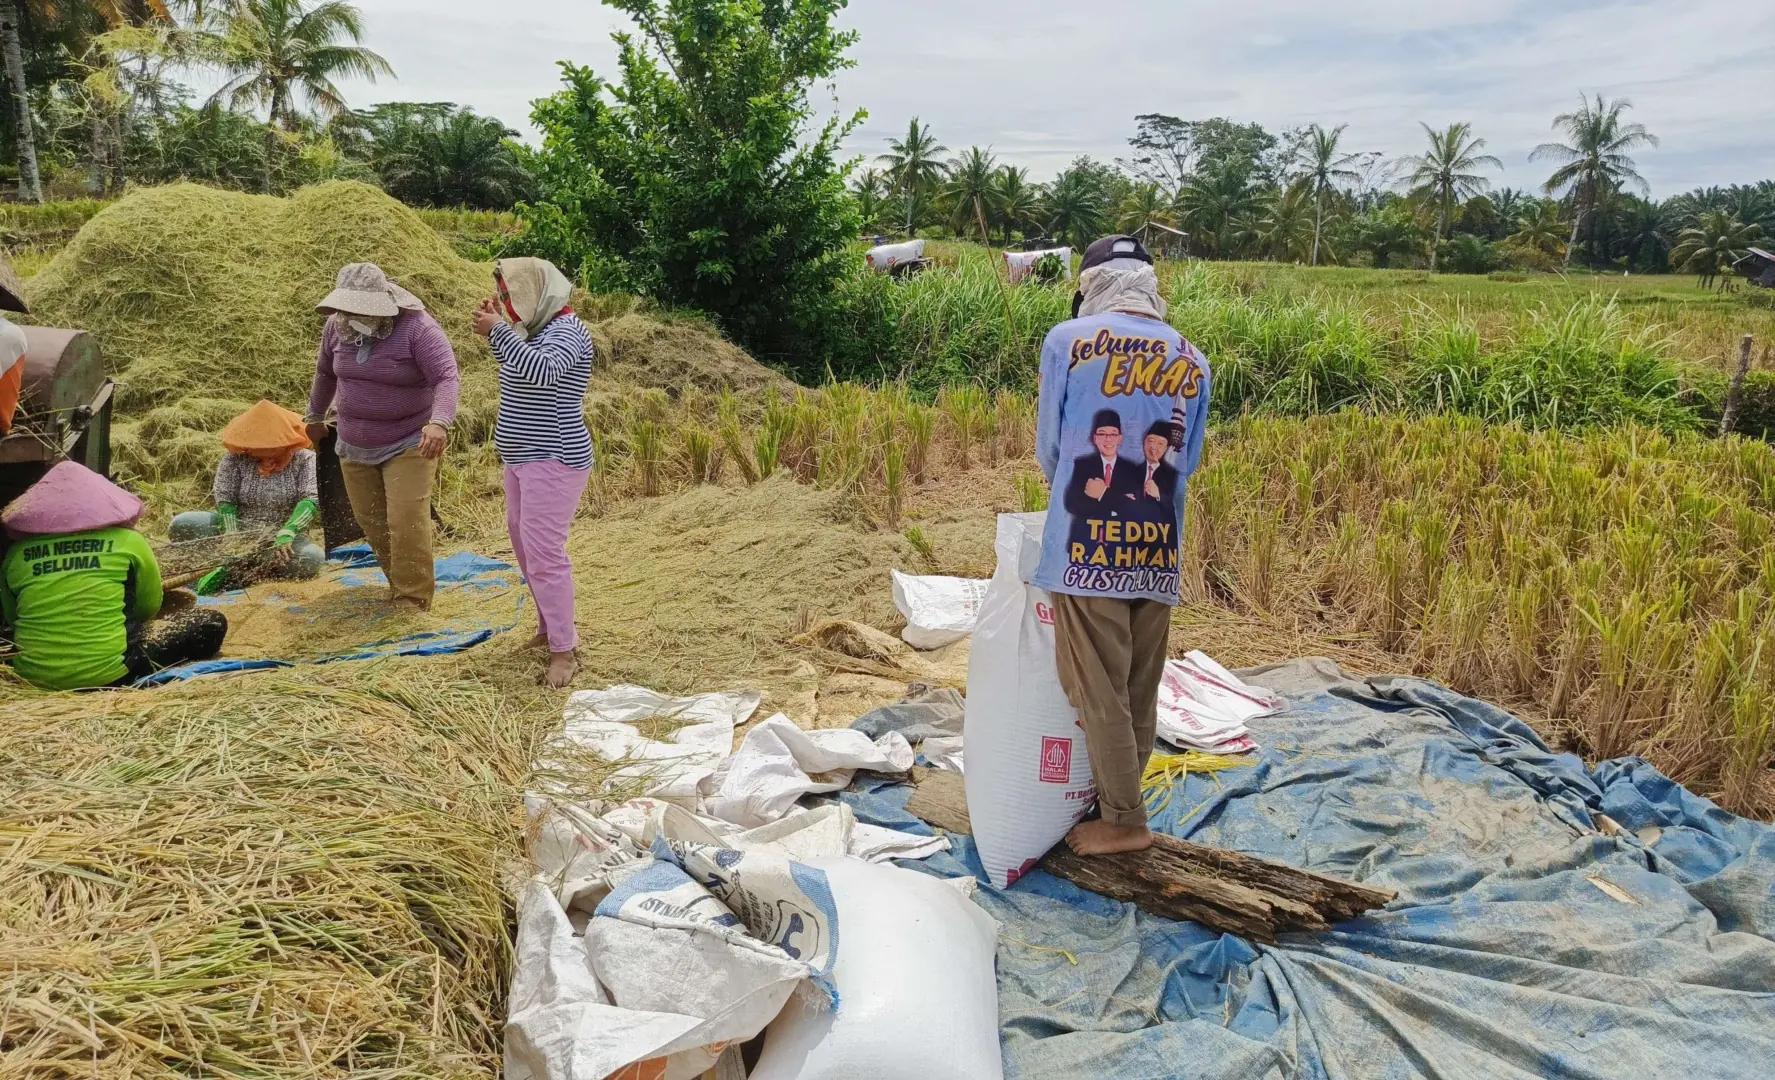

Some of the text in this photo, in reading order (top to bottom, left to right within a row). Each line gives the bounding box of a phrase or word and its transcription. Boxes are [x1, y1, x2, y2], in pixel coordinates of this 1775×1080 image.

[1101, 353, 1205, 399] EMAS
[1087, 519, 1171, 544] TEDDY
[23, 539, 114, 562] SMA NEGERI 1
[1071, 542, 1178, 569] RAHMAN
[32, 556, 101, 576] SELUMA
